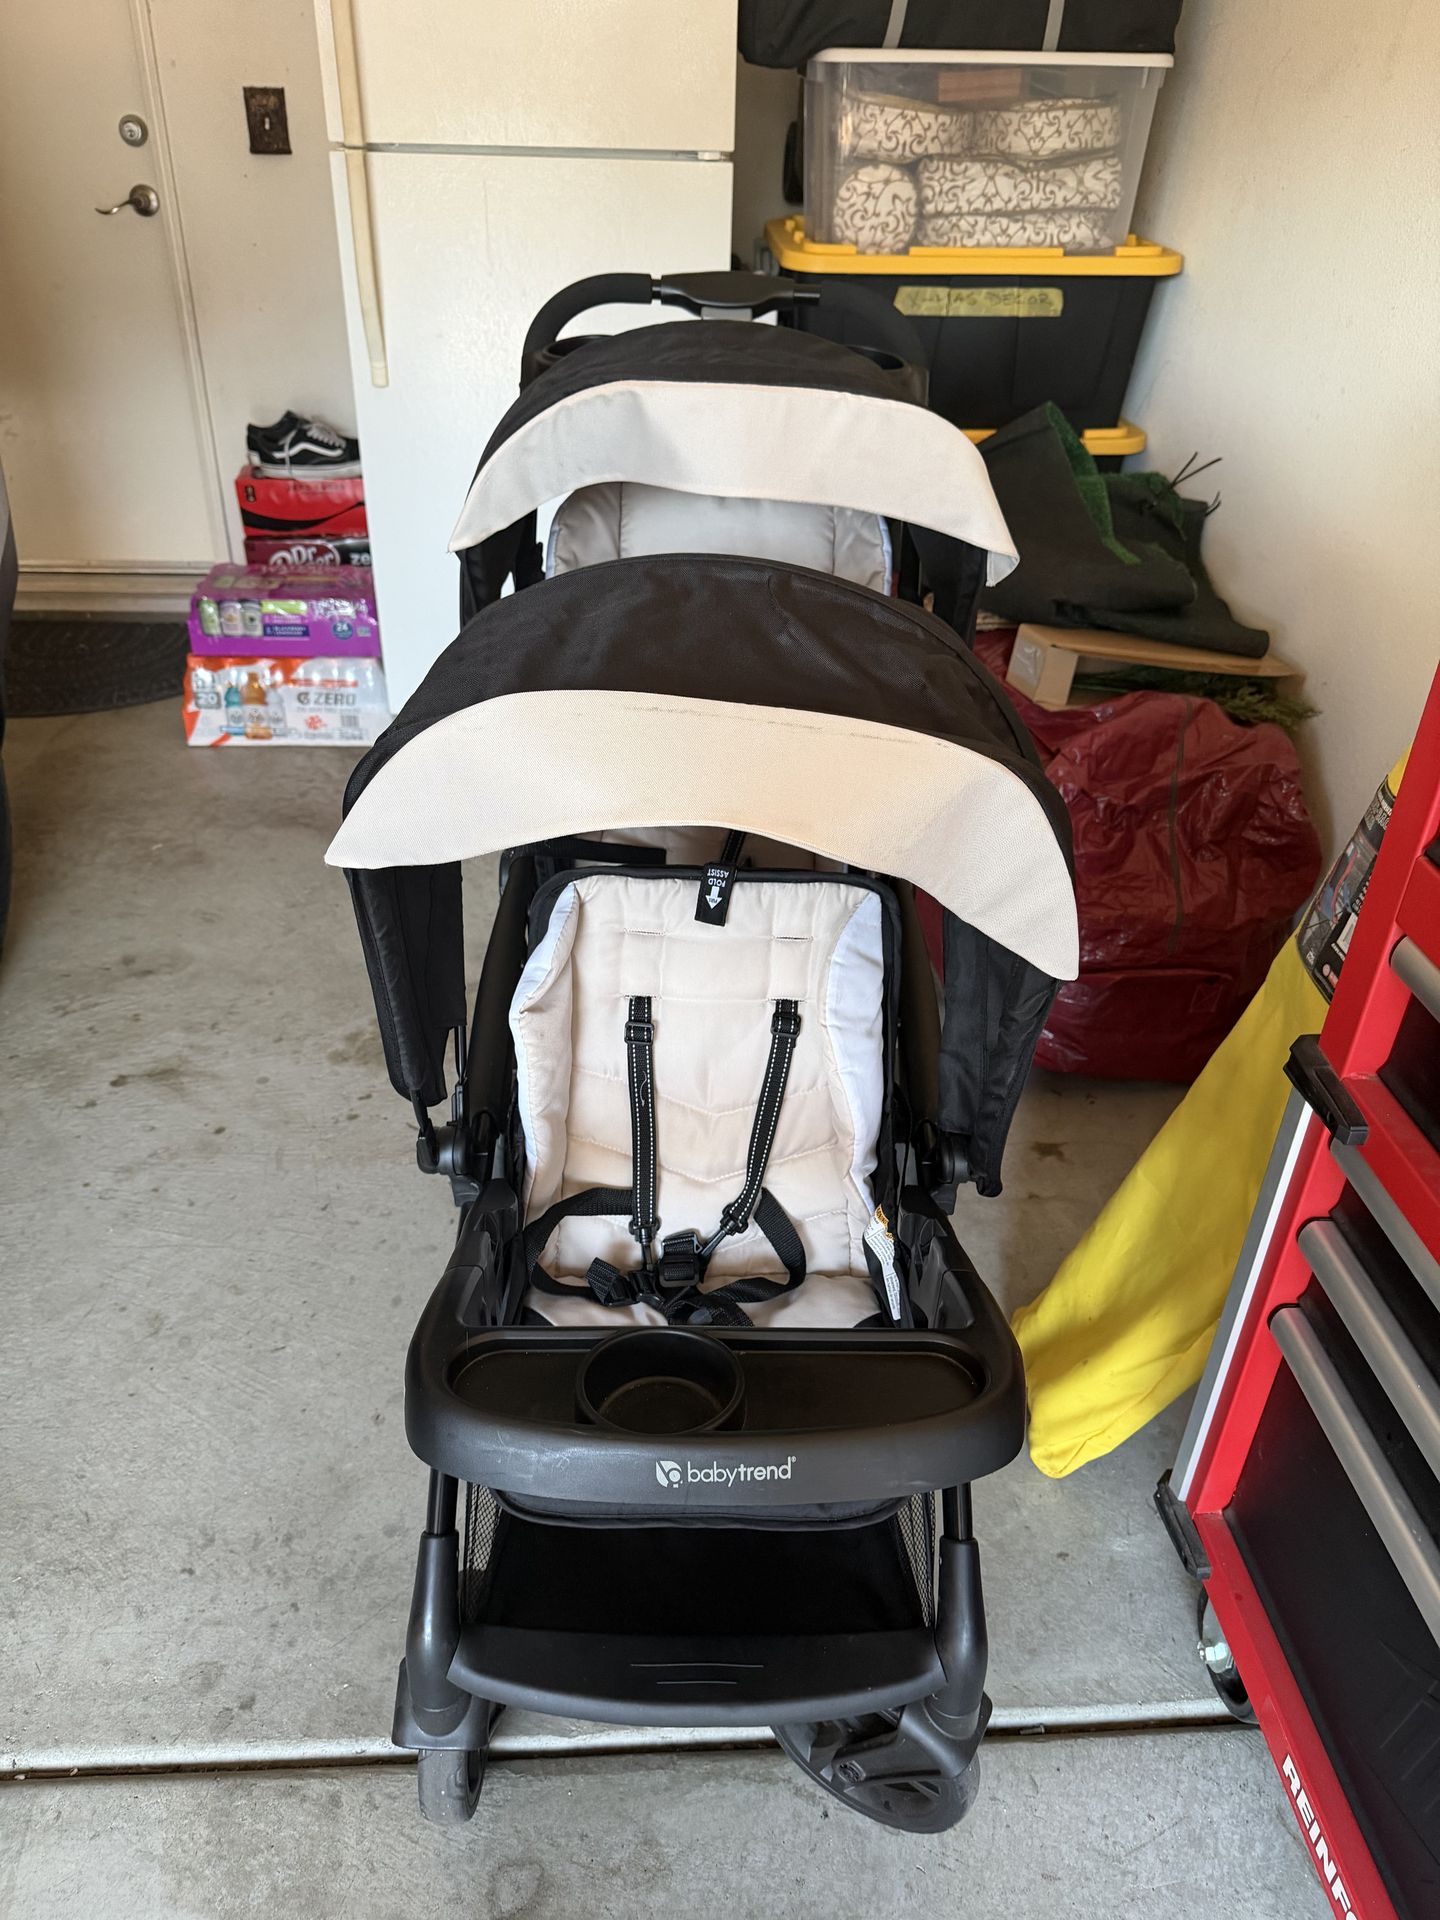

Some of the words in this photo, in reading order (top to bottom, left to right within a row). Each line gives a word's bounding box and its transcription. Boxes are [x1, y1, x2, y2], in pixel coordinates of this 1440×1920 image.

[291, 544, 317, 566] Dr
[313, 691, 357, 706] ZERO
[707, 869, 729, 878] ASSIST
[708, 878, 725, 887] FOLD
